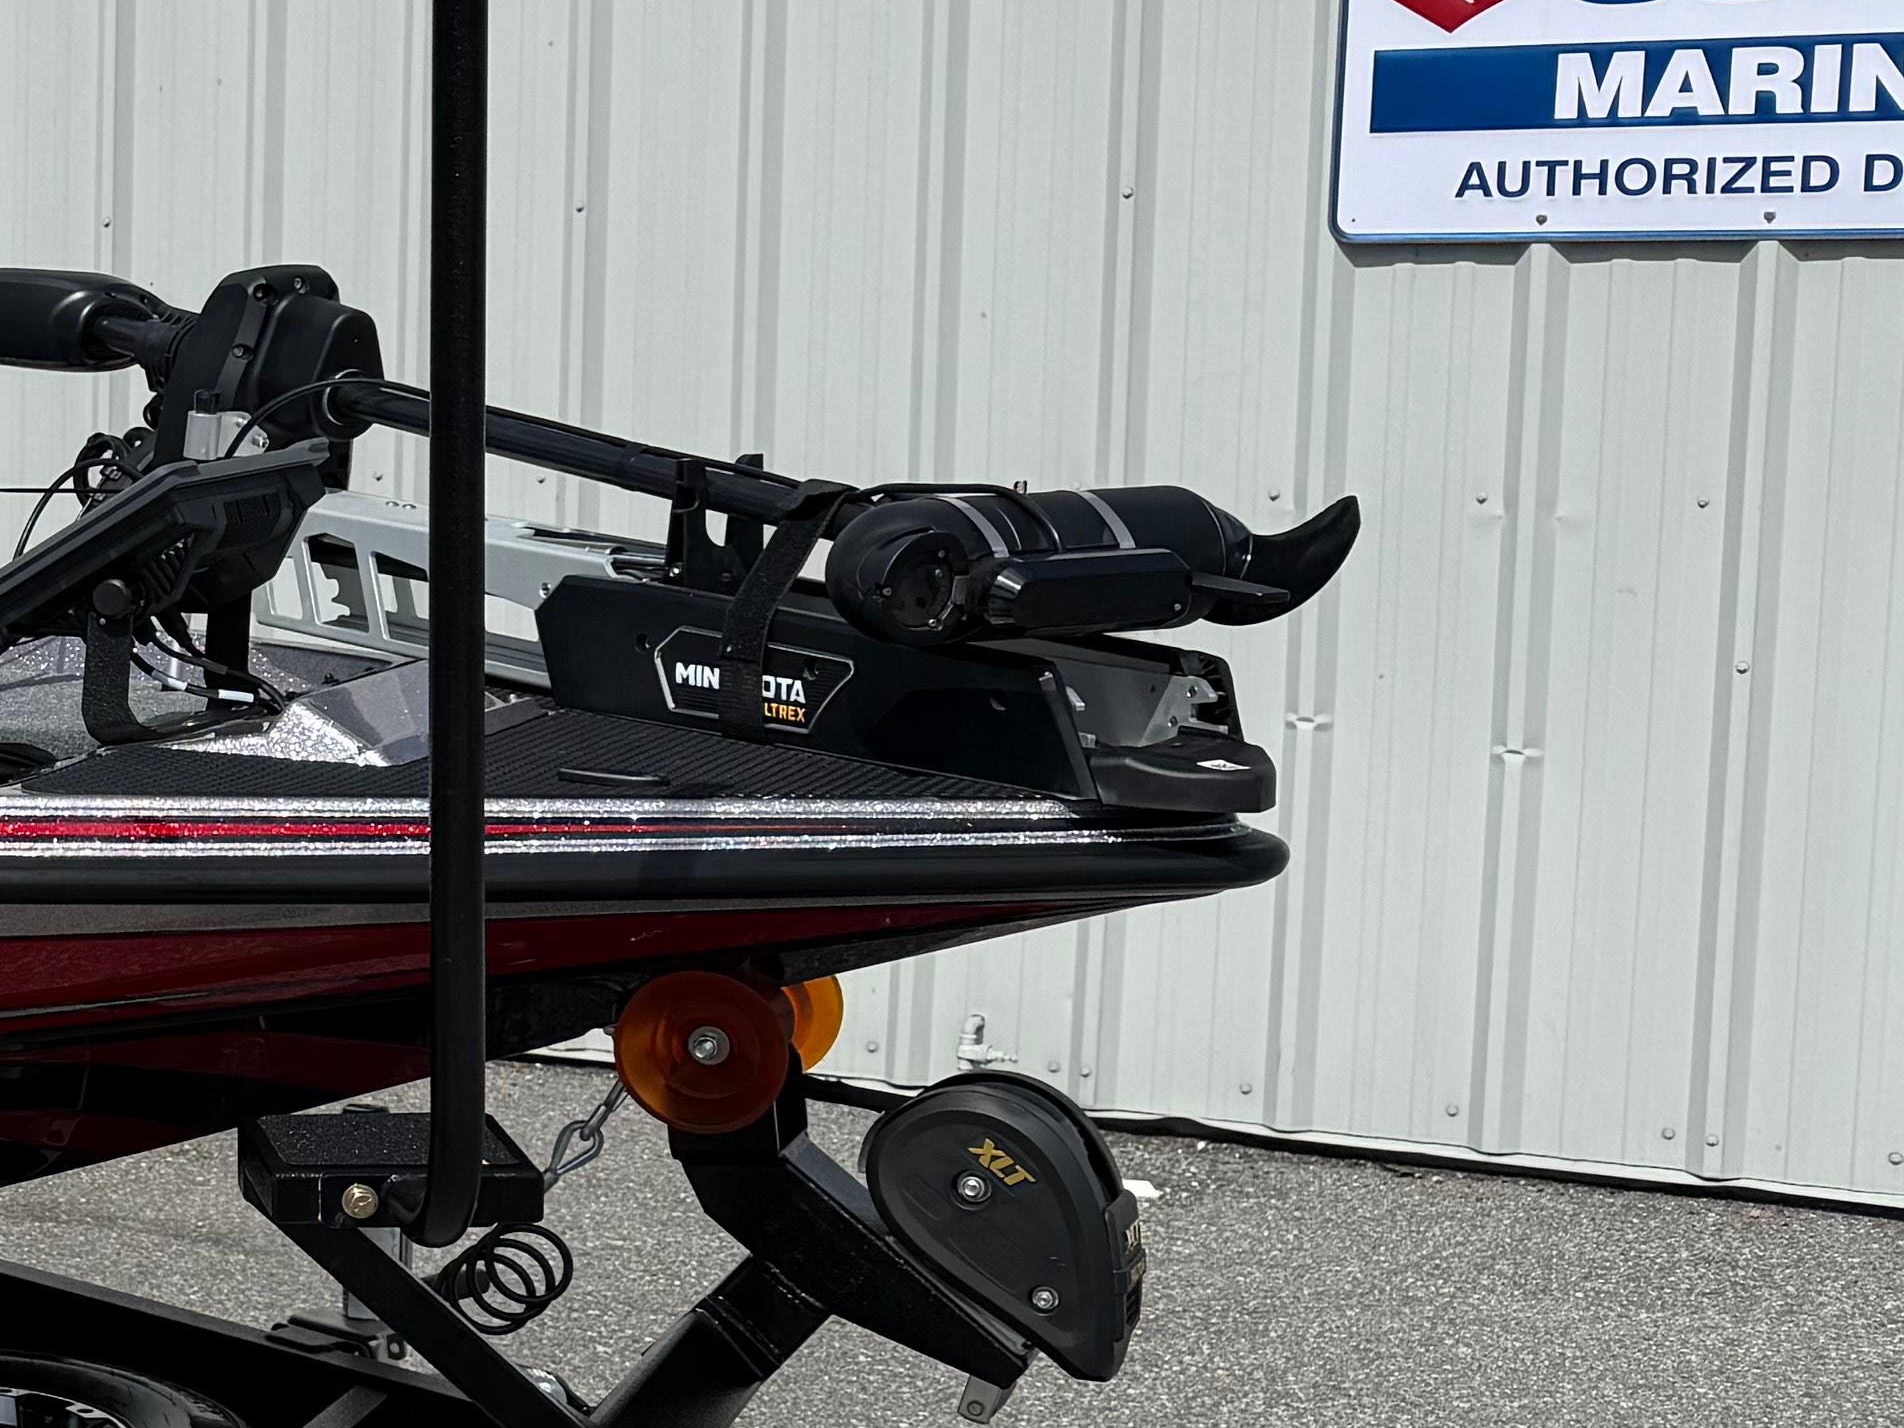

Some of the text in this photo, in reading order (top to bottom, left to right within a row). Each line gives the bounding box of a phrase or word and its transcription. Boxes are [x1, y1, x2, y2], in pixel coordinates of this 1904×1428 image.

[1454, 155, 1841, 199] AUTHORIZED
[675, 662, 806, 704] MIN OTA
[764, 703, 806, 723] LTREX
[968, 1138, 1036, 1186] XLT
